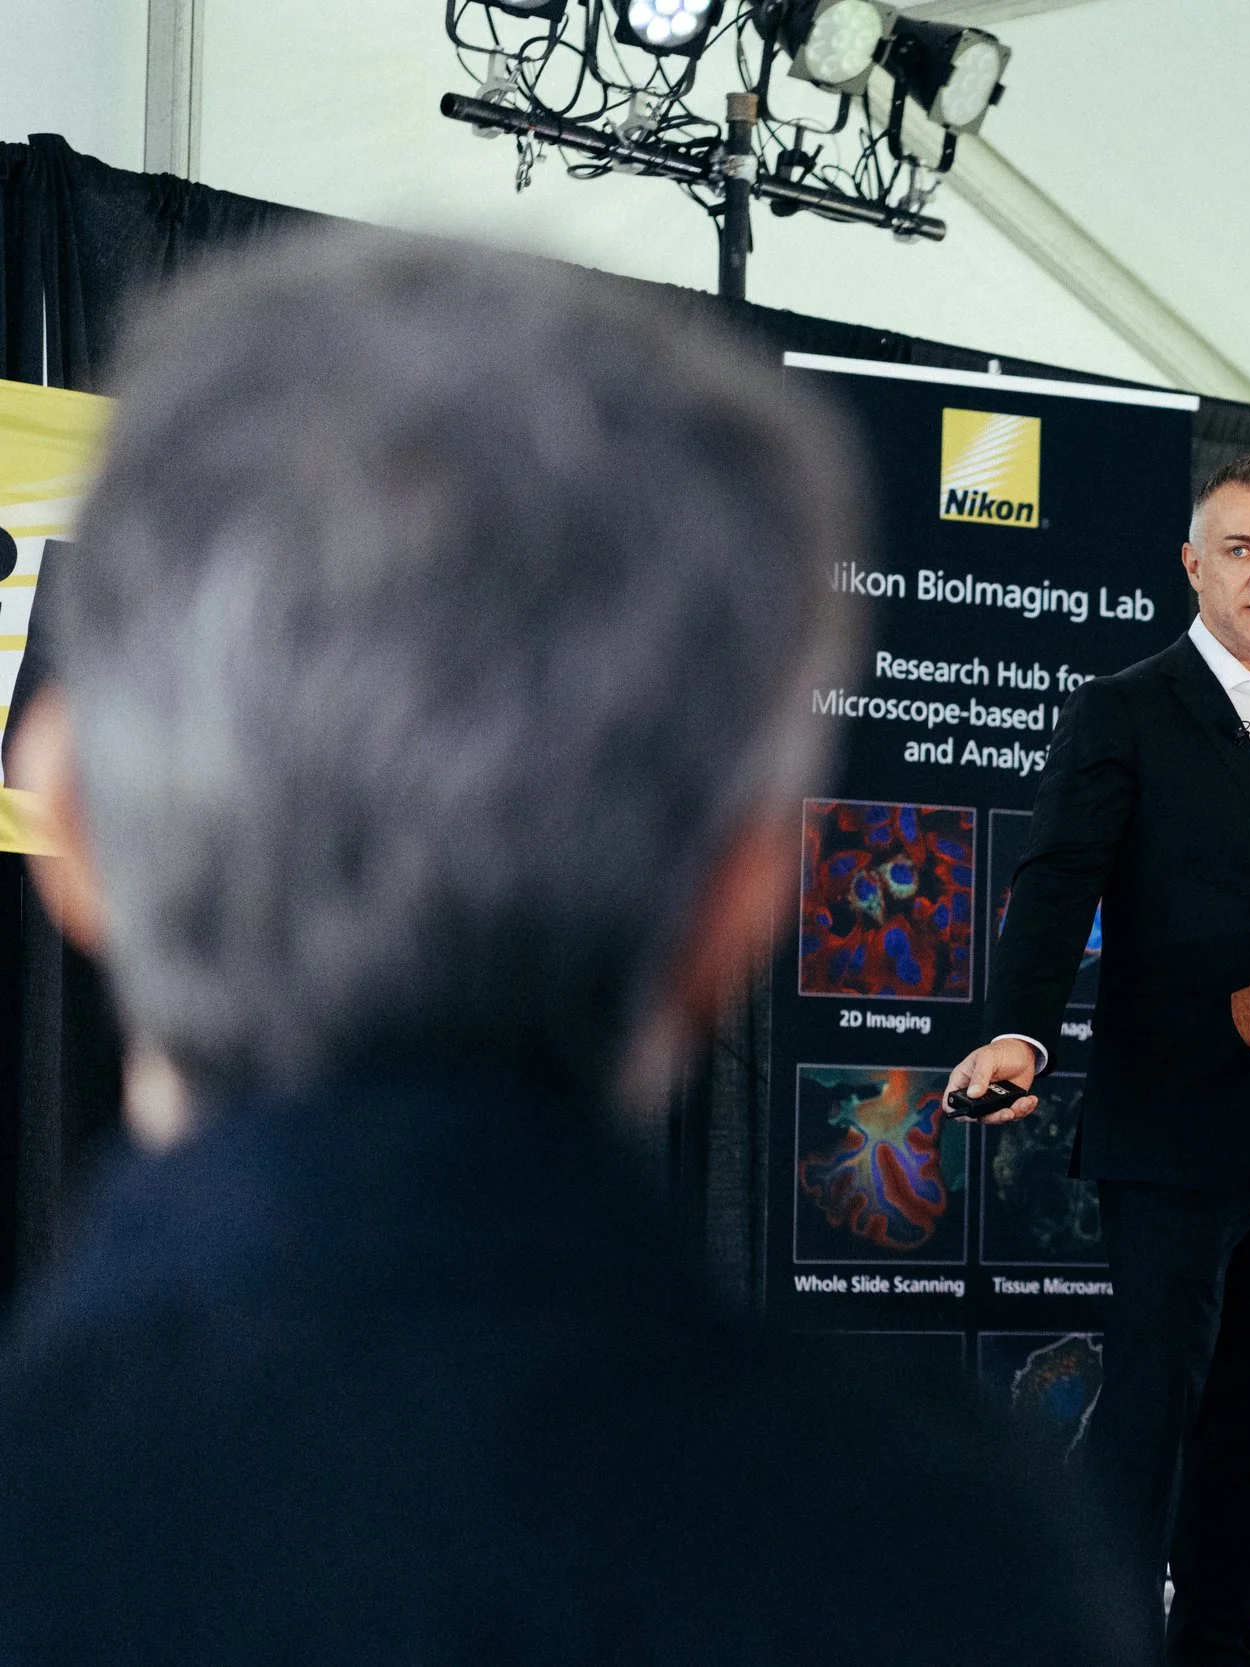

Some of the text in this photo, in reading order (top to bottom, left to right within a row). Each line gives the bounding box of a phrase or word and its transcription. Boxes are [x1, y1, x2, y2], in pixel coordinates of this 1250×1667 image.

[944, 488, 1034, 522] Nikon
[917, 569, 1089, 623] BioImaging
[1099, 586, 1155, 622] Lab
[875, 650, 990, 686] Research
[997, 661, 1051, 691] Hub
[812, 690, 1045, 729] Microscope-based
[903, 736, 1051, 777] and Analys
[839, 1009, 932, 1035] 2D Imaging
[793, 1274, 965, 1298] Whole Slide Scanning
[992, 1276, 1041, 1295] Tissue
